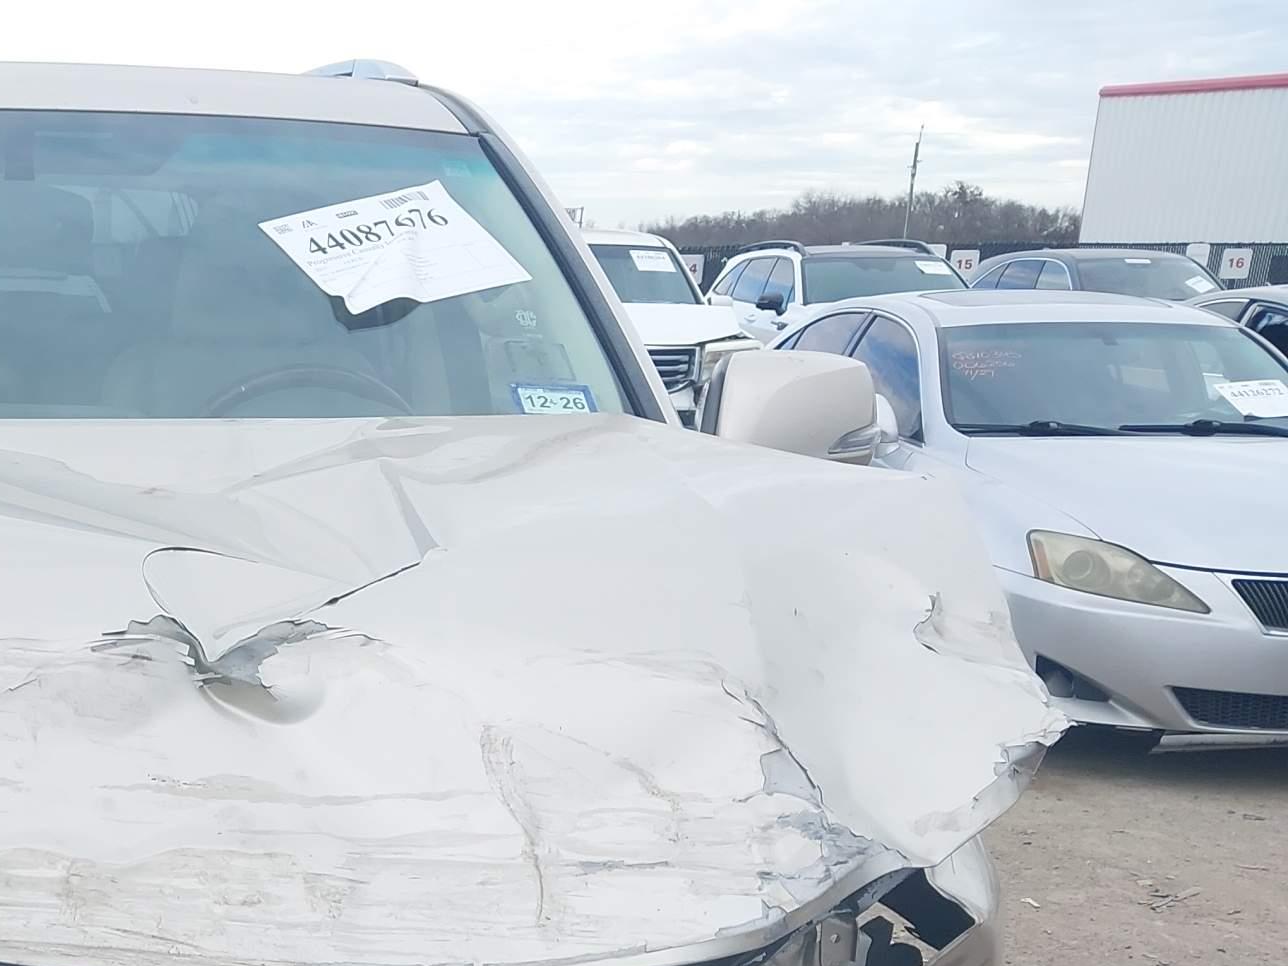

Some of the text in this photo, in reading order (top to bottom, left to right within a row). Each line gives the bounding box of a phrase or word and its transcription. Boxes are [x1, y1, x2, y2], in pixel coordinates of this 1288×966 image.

[308, 208, 449, 255] 44087676
[688, 263, 697, 274] 4
[956, 259, 973, 270] 15
[1228, 257, 1245, 269] 16
